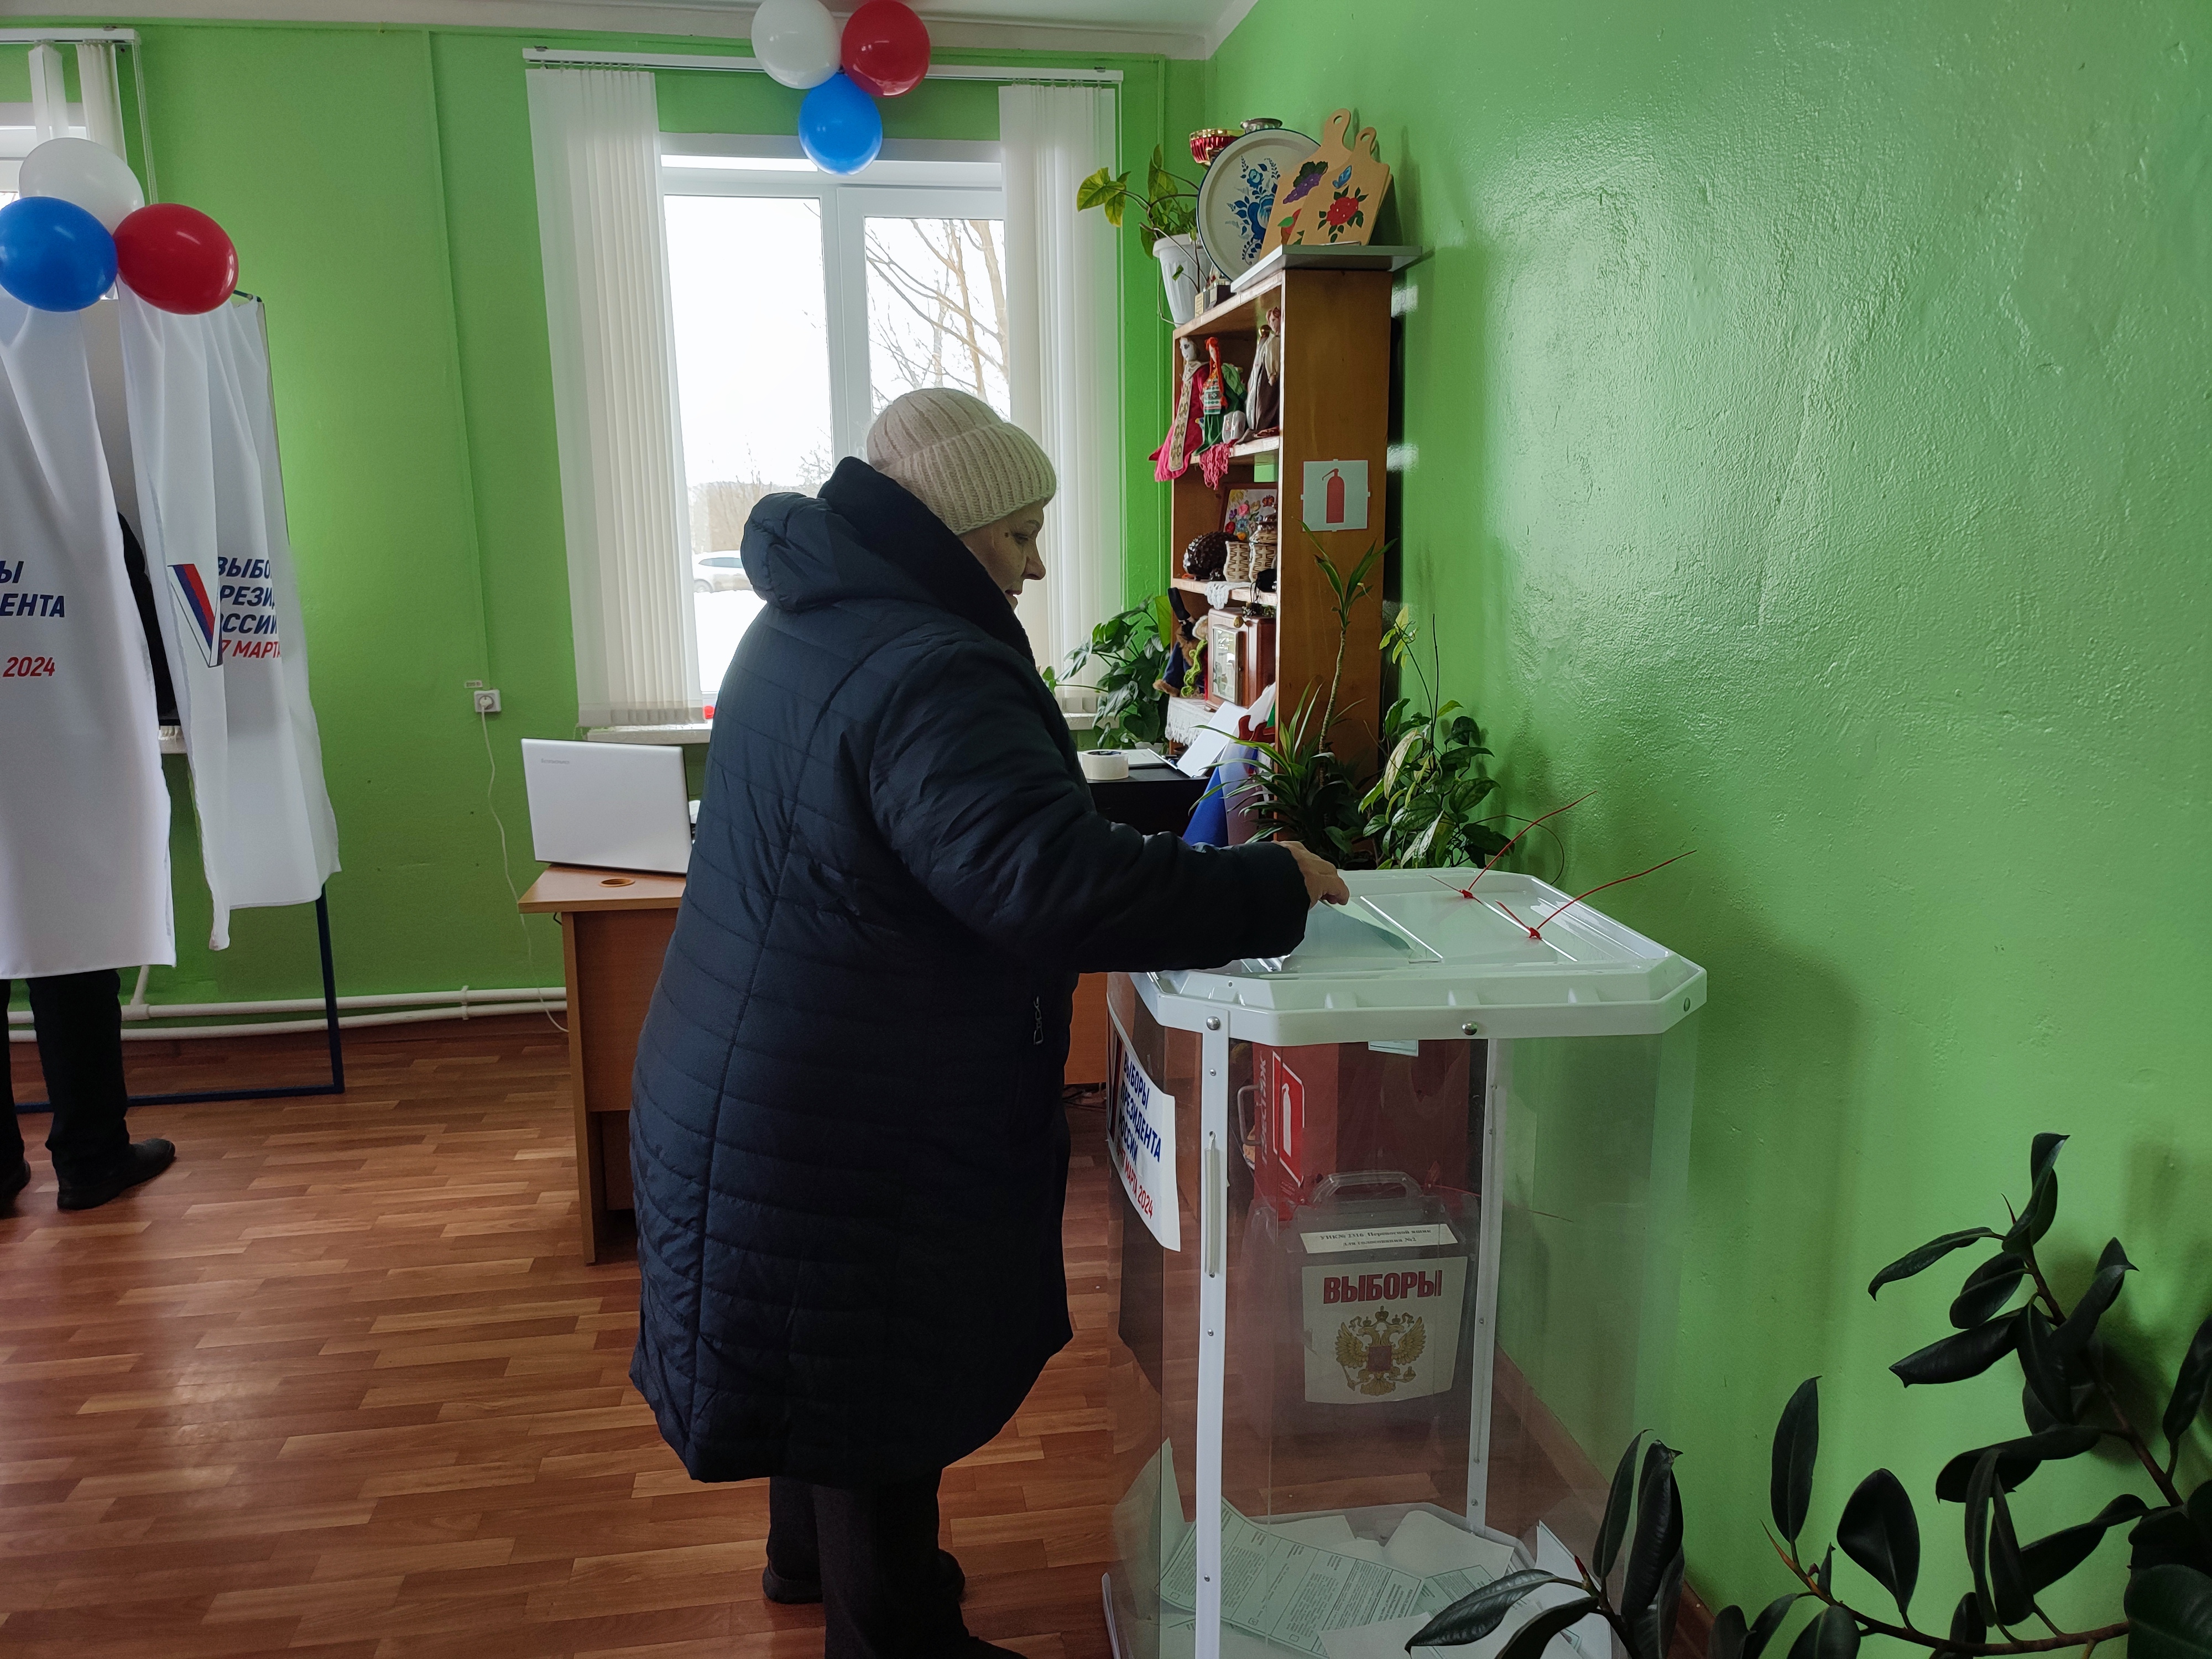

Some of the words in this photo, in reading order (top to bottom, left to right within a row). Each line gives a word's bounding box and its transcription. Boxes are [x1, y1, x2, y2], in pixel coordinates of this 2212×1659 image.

[218, 556, 272, 579] ВЫБО
[0, 593, 65, 617] ЕНТА
[220, 585, 275, 610] РЕЗИ
[221, 613, 277, 634] ССИИ
[3, 656, 55, 677] 2024
[1124, 1051, 1150, 1110] ВЫБОРЫ
[1121, 1080, 1161, 1163] ПРЕЗИДЕНТА
[1118, 1108, 1138, 1165] РОССИИ
[1124, 1156, 1138, 1198] МАРТА
[1138, 1185, 1153, 1219] 2024
[1323, 1270, 1442, 1304] ВЫБОРЫ
